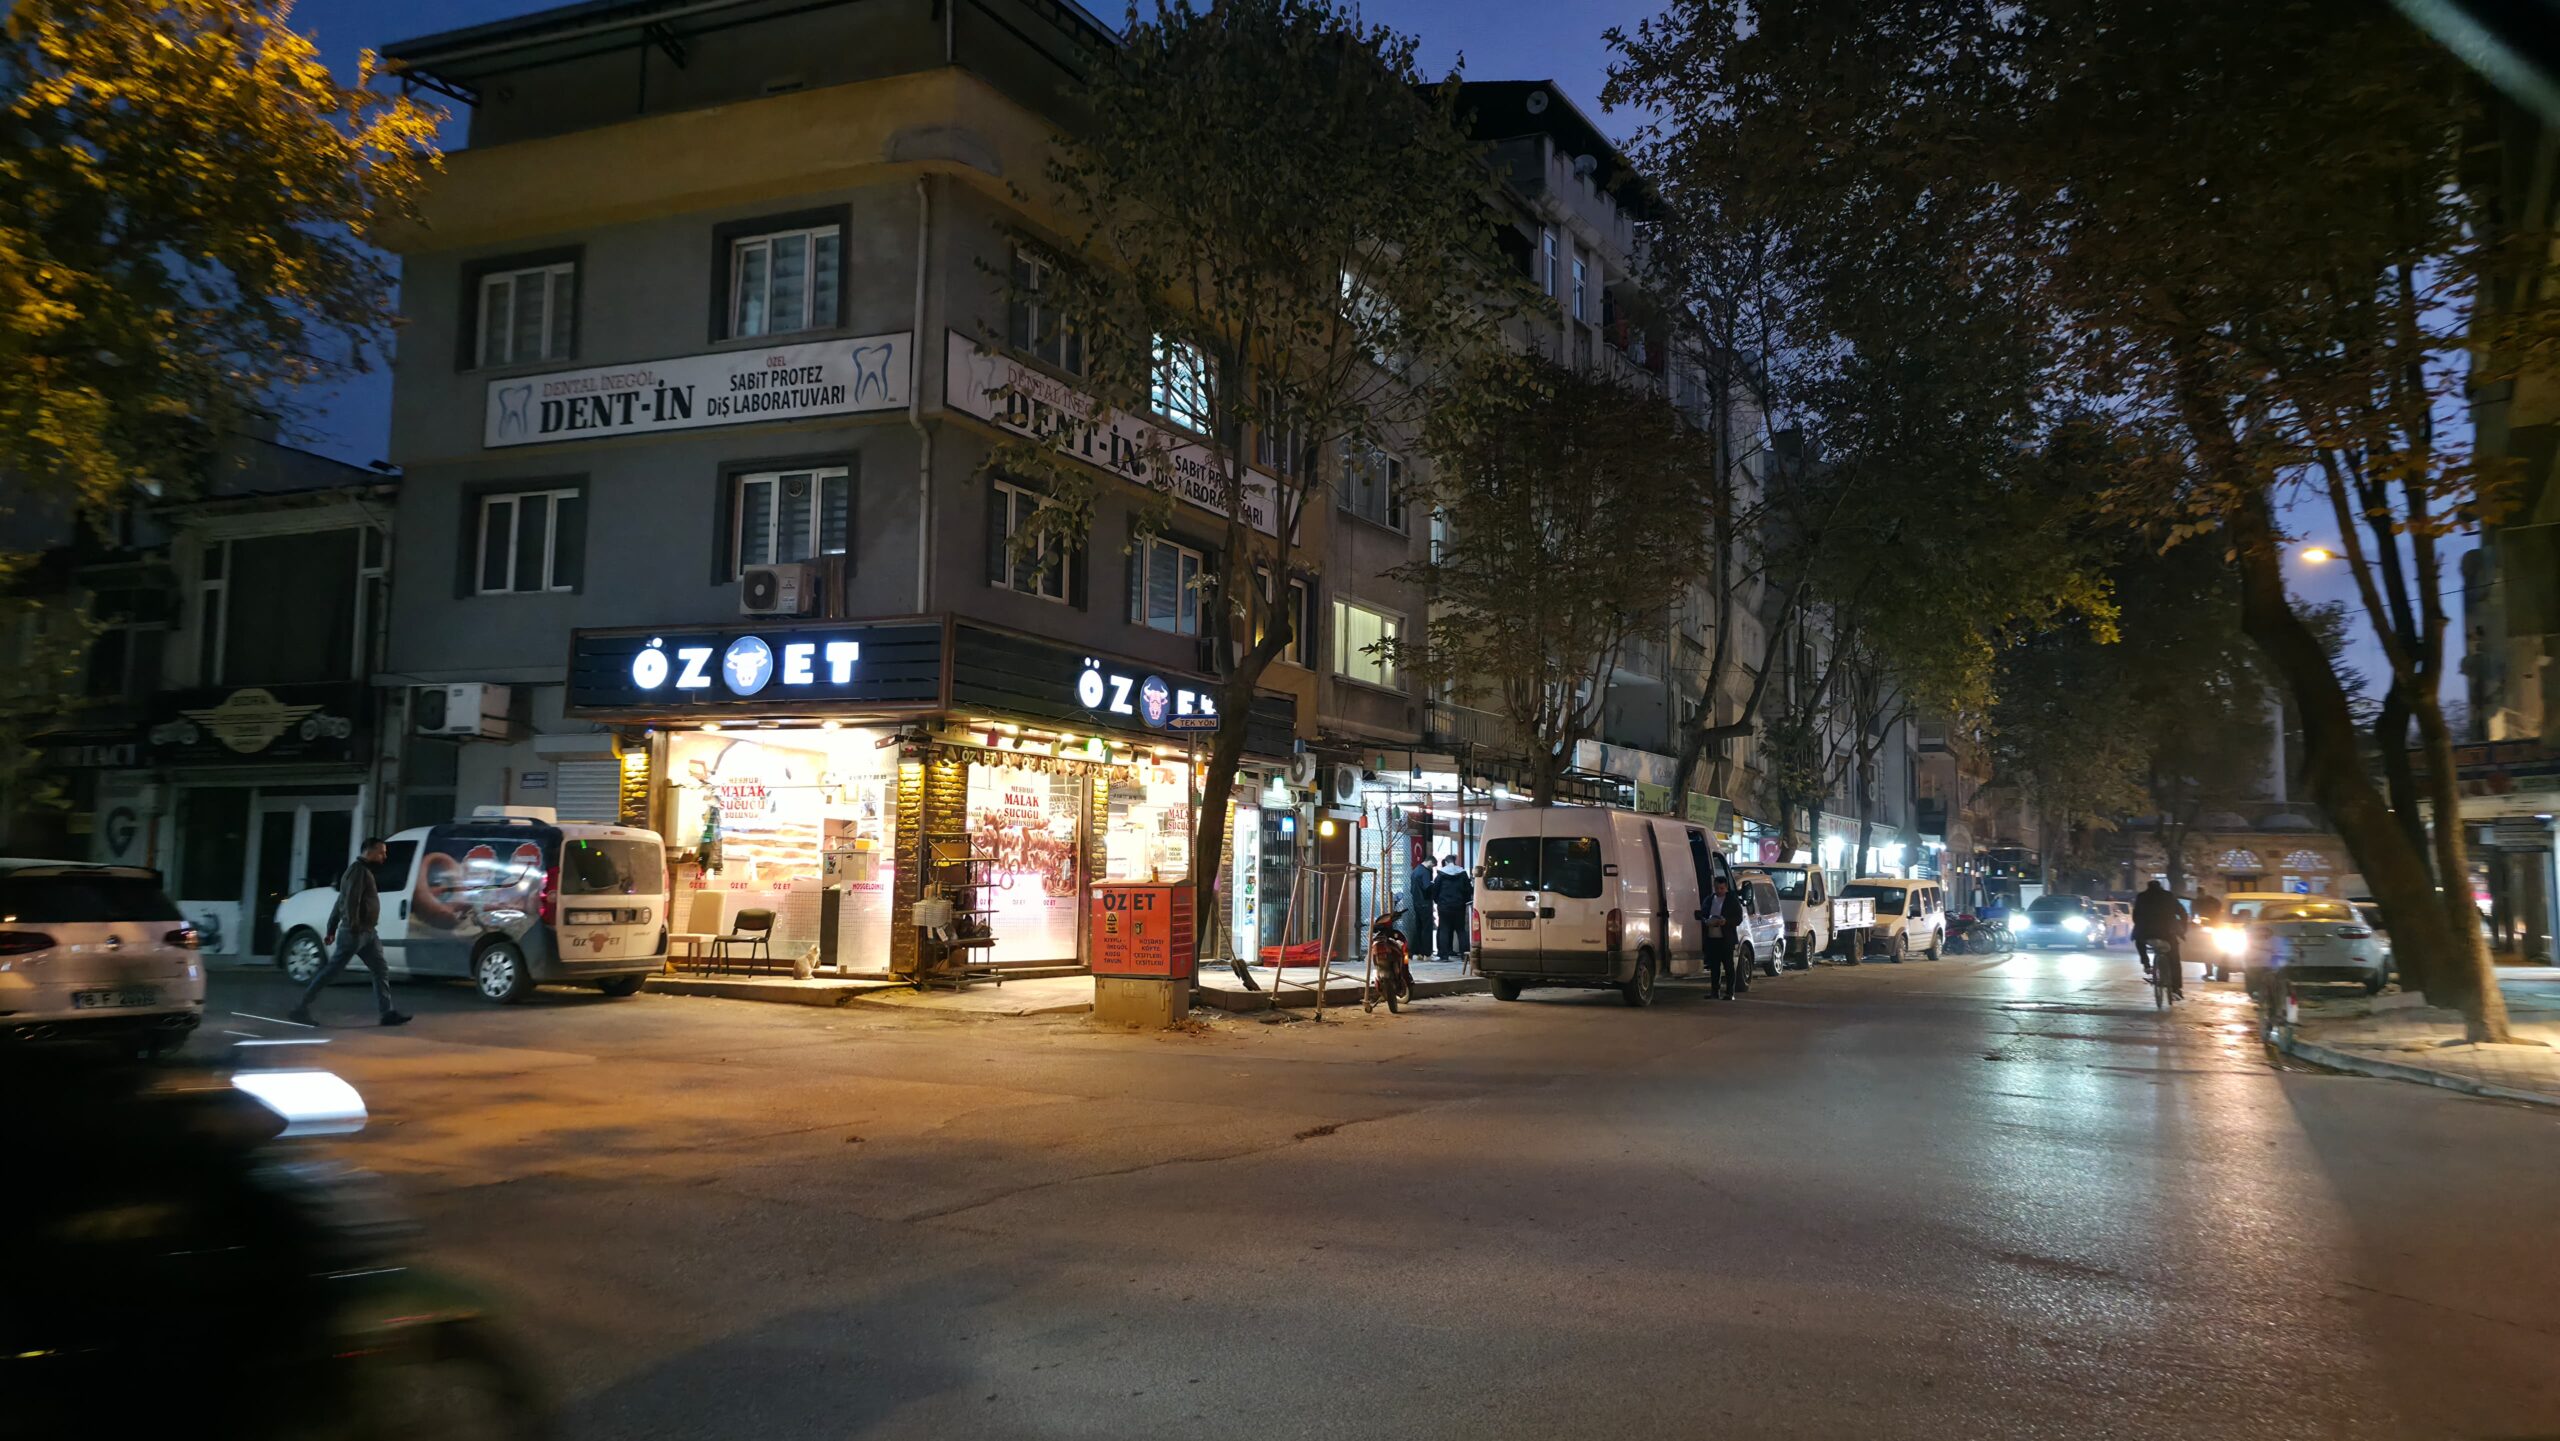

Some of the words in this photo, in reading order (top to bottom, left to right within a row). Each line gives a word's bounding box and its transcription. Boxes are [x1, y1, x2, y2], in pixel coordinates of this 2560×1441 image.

[544, 378, 599, 396] DENTAL
[601, 370, 656, 391] İNEGÖL
[771, 366, 822, 387] PROTEZ
[539, 380, 696, 433] DENT-İN
[734, 385, 845, 414] LABORATUVARI
[784, 642, 859, 684] ET
[1080, 657, 1133, 714] ÖZ
[1198, 717, 1215, 727] YÖN
[962, 748, 976, 761] ÖZ
[720, 786, 766, 797] MALAK
[1005, 793, 1039, 807] MALAK
[1638, 790, 1661, 814] Burak
[1004, 806, 1039, 819] SUCUĞU
[783, 882, 791, 890] ET
[1103, 890, 1128, 911] ÖZ
[1133, 893, 1156, 910] ET
[610, 937, 621, 945] ET
